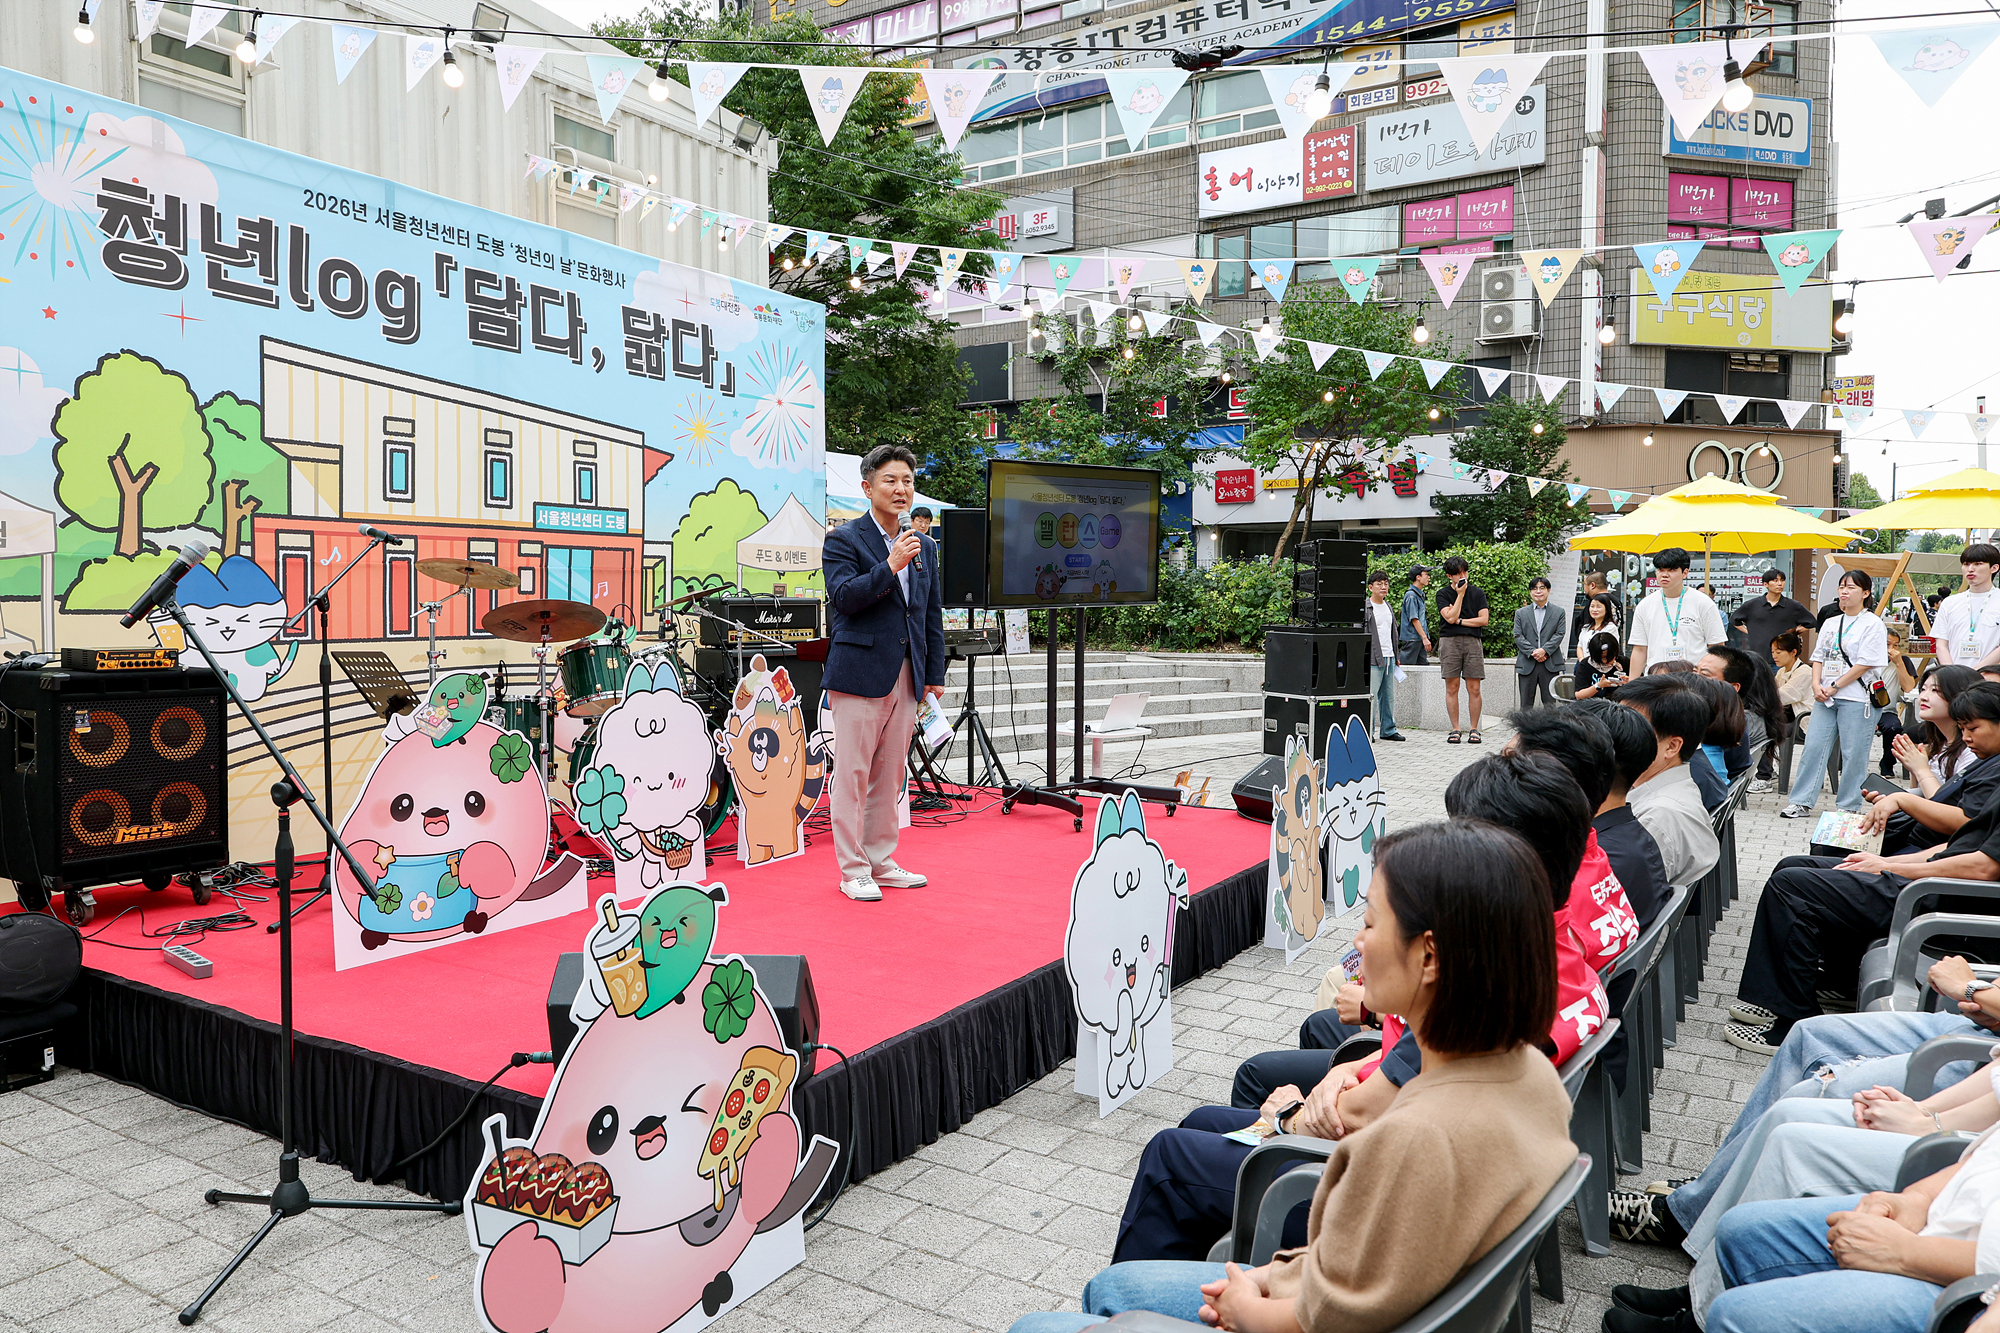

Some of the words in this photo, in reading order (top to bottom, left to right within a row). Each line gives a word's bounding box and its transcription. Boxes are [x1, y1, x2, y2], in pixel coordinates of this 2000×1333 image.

[1014, 0, 1325, 71] 창동IT컴퓨터
[1095, 57, 1130, 70] DONG
[1135, 53, 1149, 63] IT
[1233, 17, 1304, 40] ACADEMY
[1350, 87, 1396, 107] 회원모집
[1517, 100, 1533, 112] 3F
[1380, 119, 1432, 141] 1번가
[1754, 110, 1794, 138] DVD
[1257, 172, 1300, 192] 이야기
[1680, 184, 1715, 201] 1번가
[1745, 190, 1780, 206] 1번가
[1412, 205, 1452, 221] 1번가
[1467, 199, 1508, 216] 1번가
[303, 189, 367, 224] 2026년
[374, 207, 470, 247] 서울청년센터
[476, 235, 505, 257] 도봉
[1033, 212, 1048, 224] 3F
[1647, 290, 1766, 329] 구구식당
[1739, 334, 1749, 343] 2F
[1265, 480, 1290, 488] SINCE
[537, 510, 602, 528] 서울청년센터
[605, 515, 625, 530] 도봉
[1100, 526, 1120, 536] Game
[756, 549, 772, 562] 푸드
[775, 551, 782, 562] &
[784, 550, 807, 564] 이벤트
[754, 610, 793, 624] Marsll
[115, 821, 176, 838] Mark
[123, 829, 175, 843] bass
